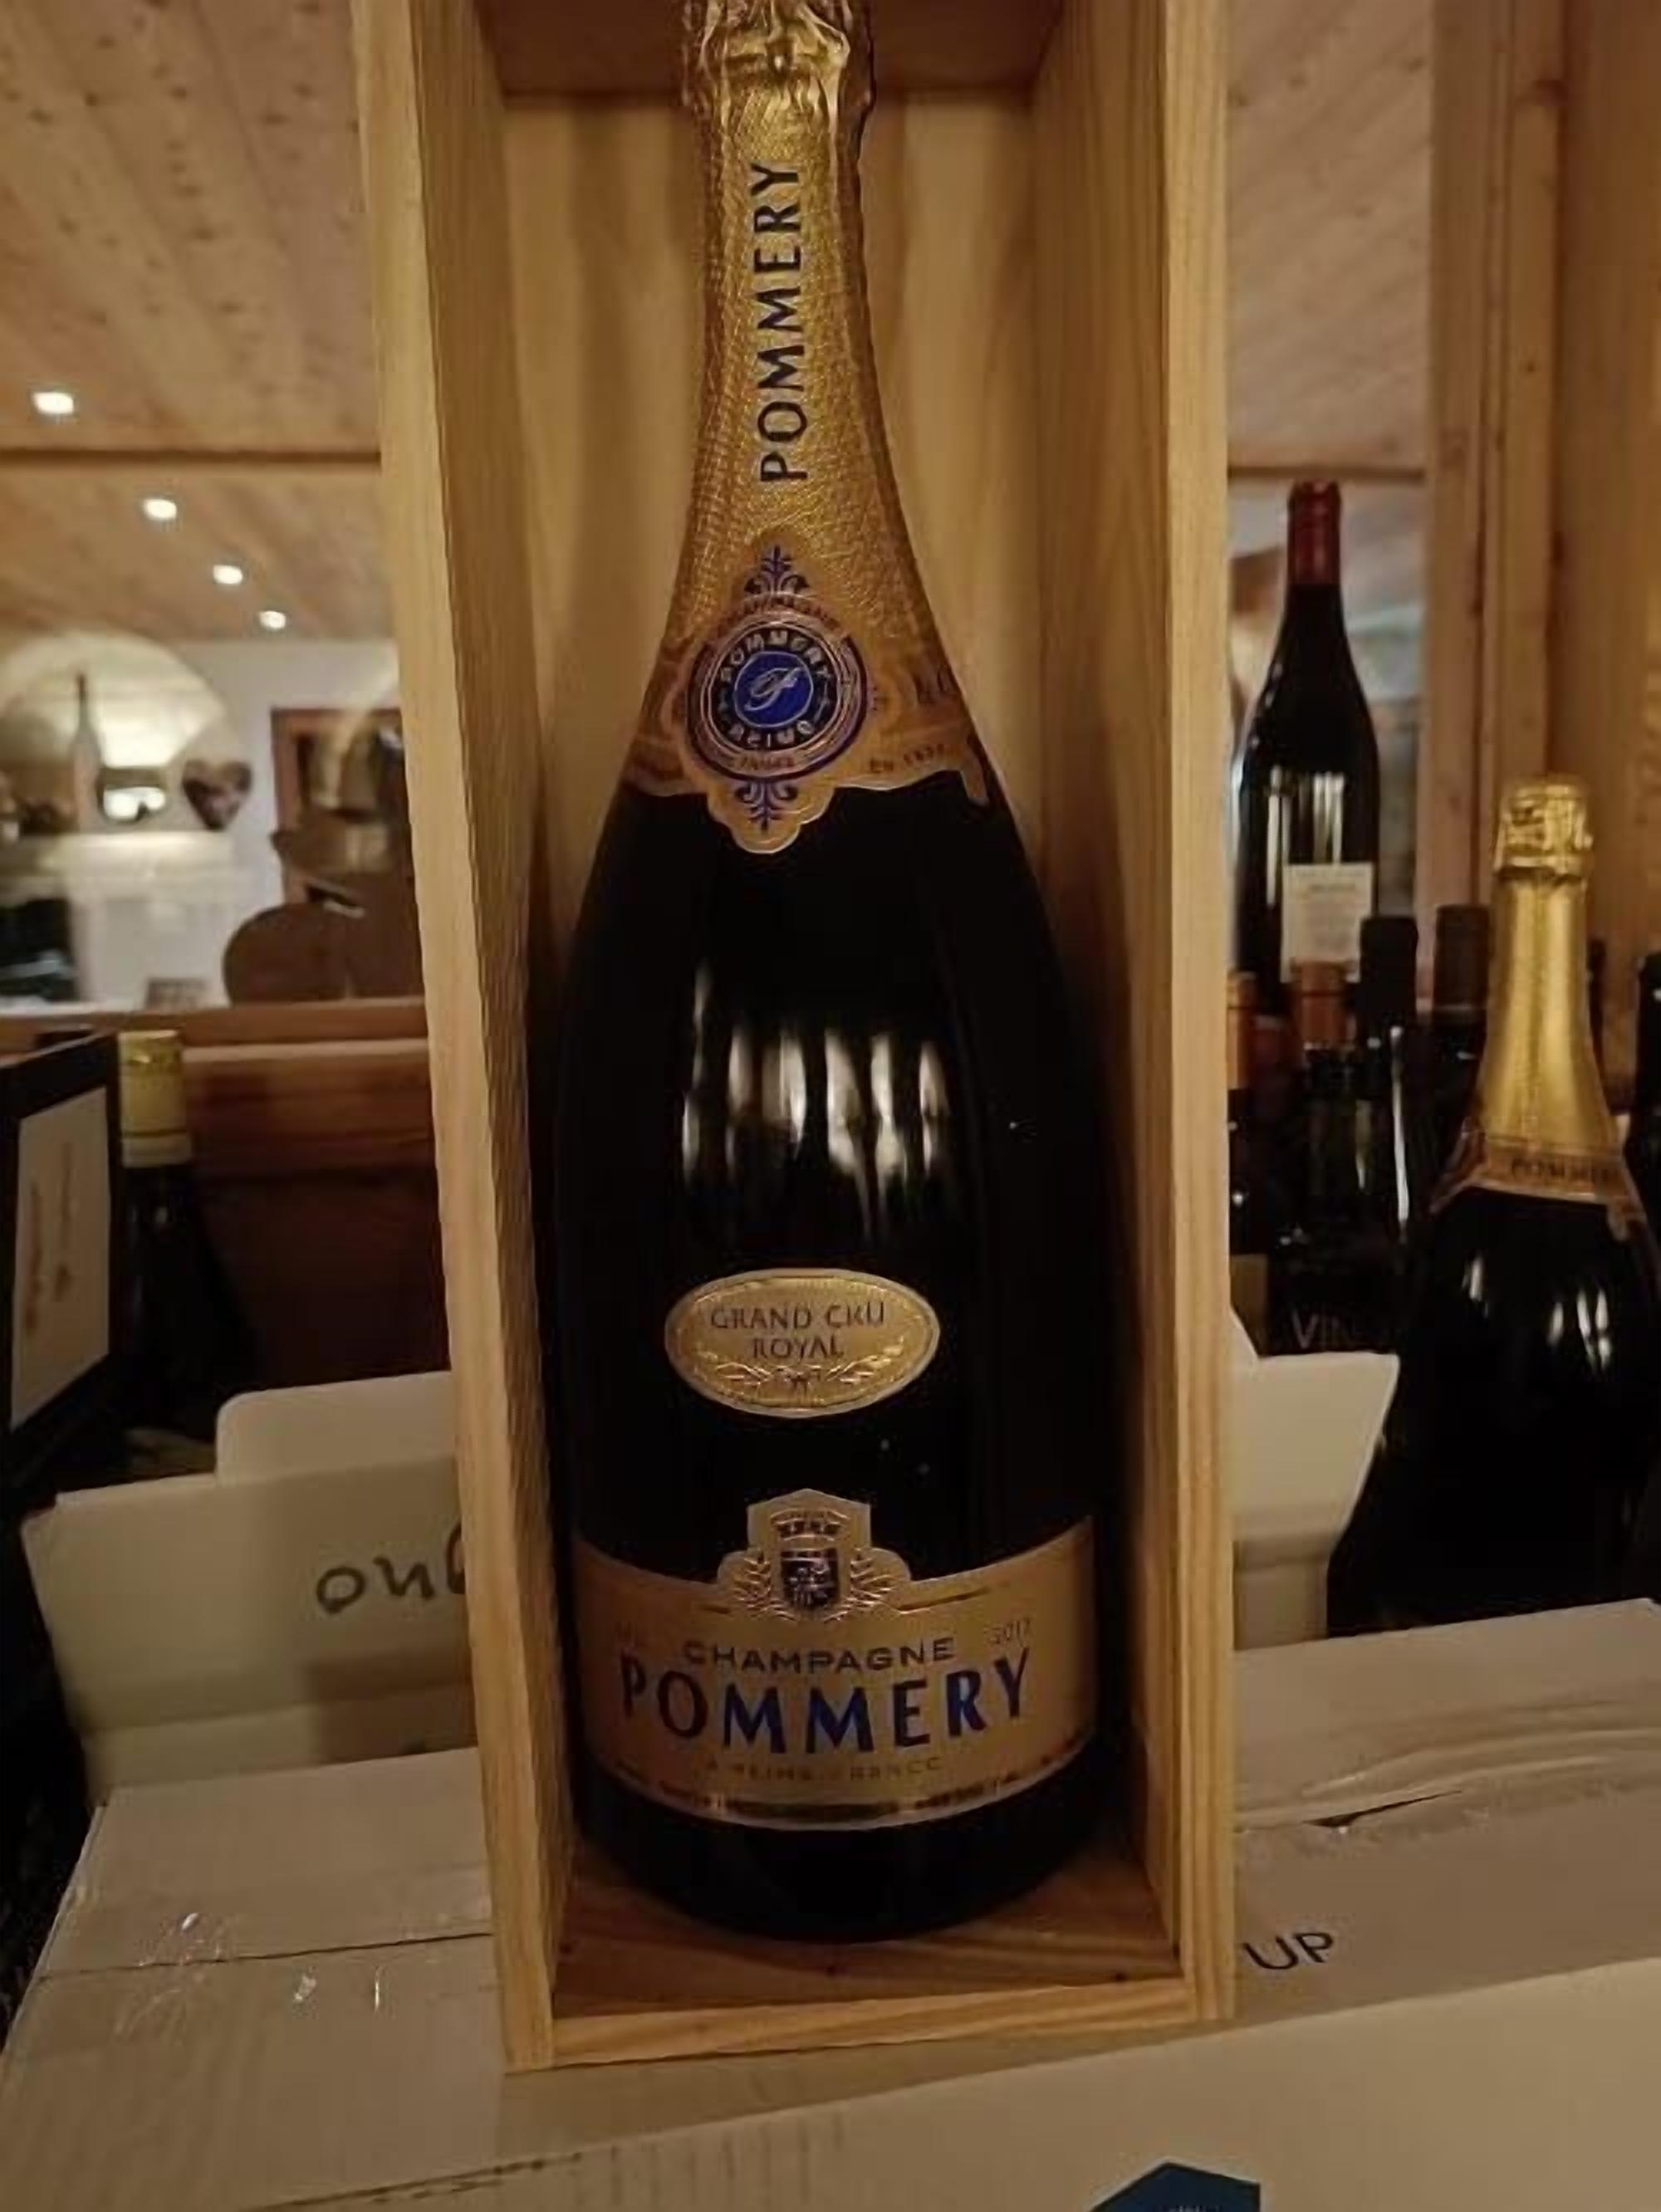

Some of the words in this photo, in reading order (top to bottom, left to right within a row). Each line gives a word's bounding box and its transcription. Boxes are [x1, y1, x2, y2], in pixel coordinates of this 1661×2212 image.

[751, 163, 808, 482] POMMERY
[711, 1305, 811, 1330] GRAND
[824, 1300, 884, 1328] CRU
[752, 1336, 844, 1361] ROYAL
[682, 1636, 957, 1676] CHAMPAGNE
[620, 1647, 1030, 1755] POMMERY
[1242, 1931, 1335, 1971] UP
